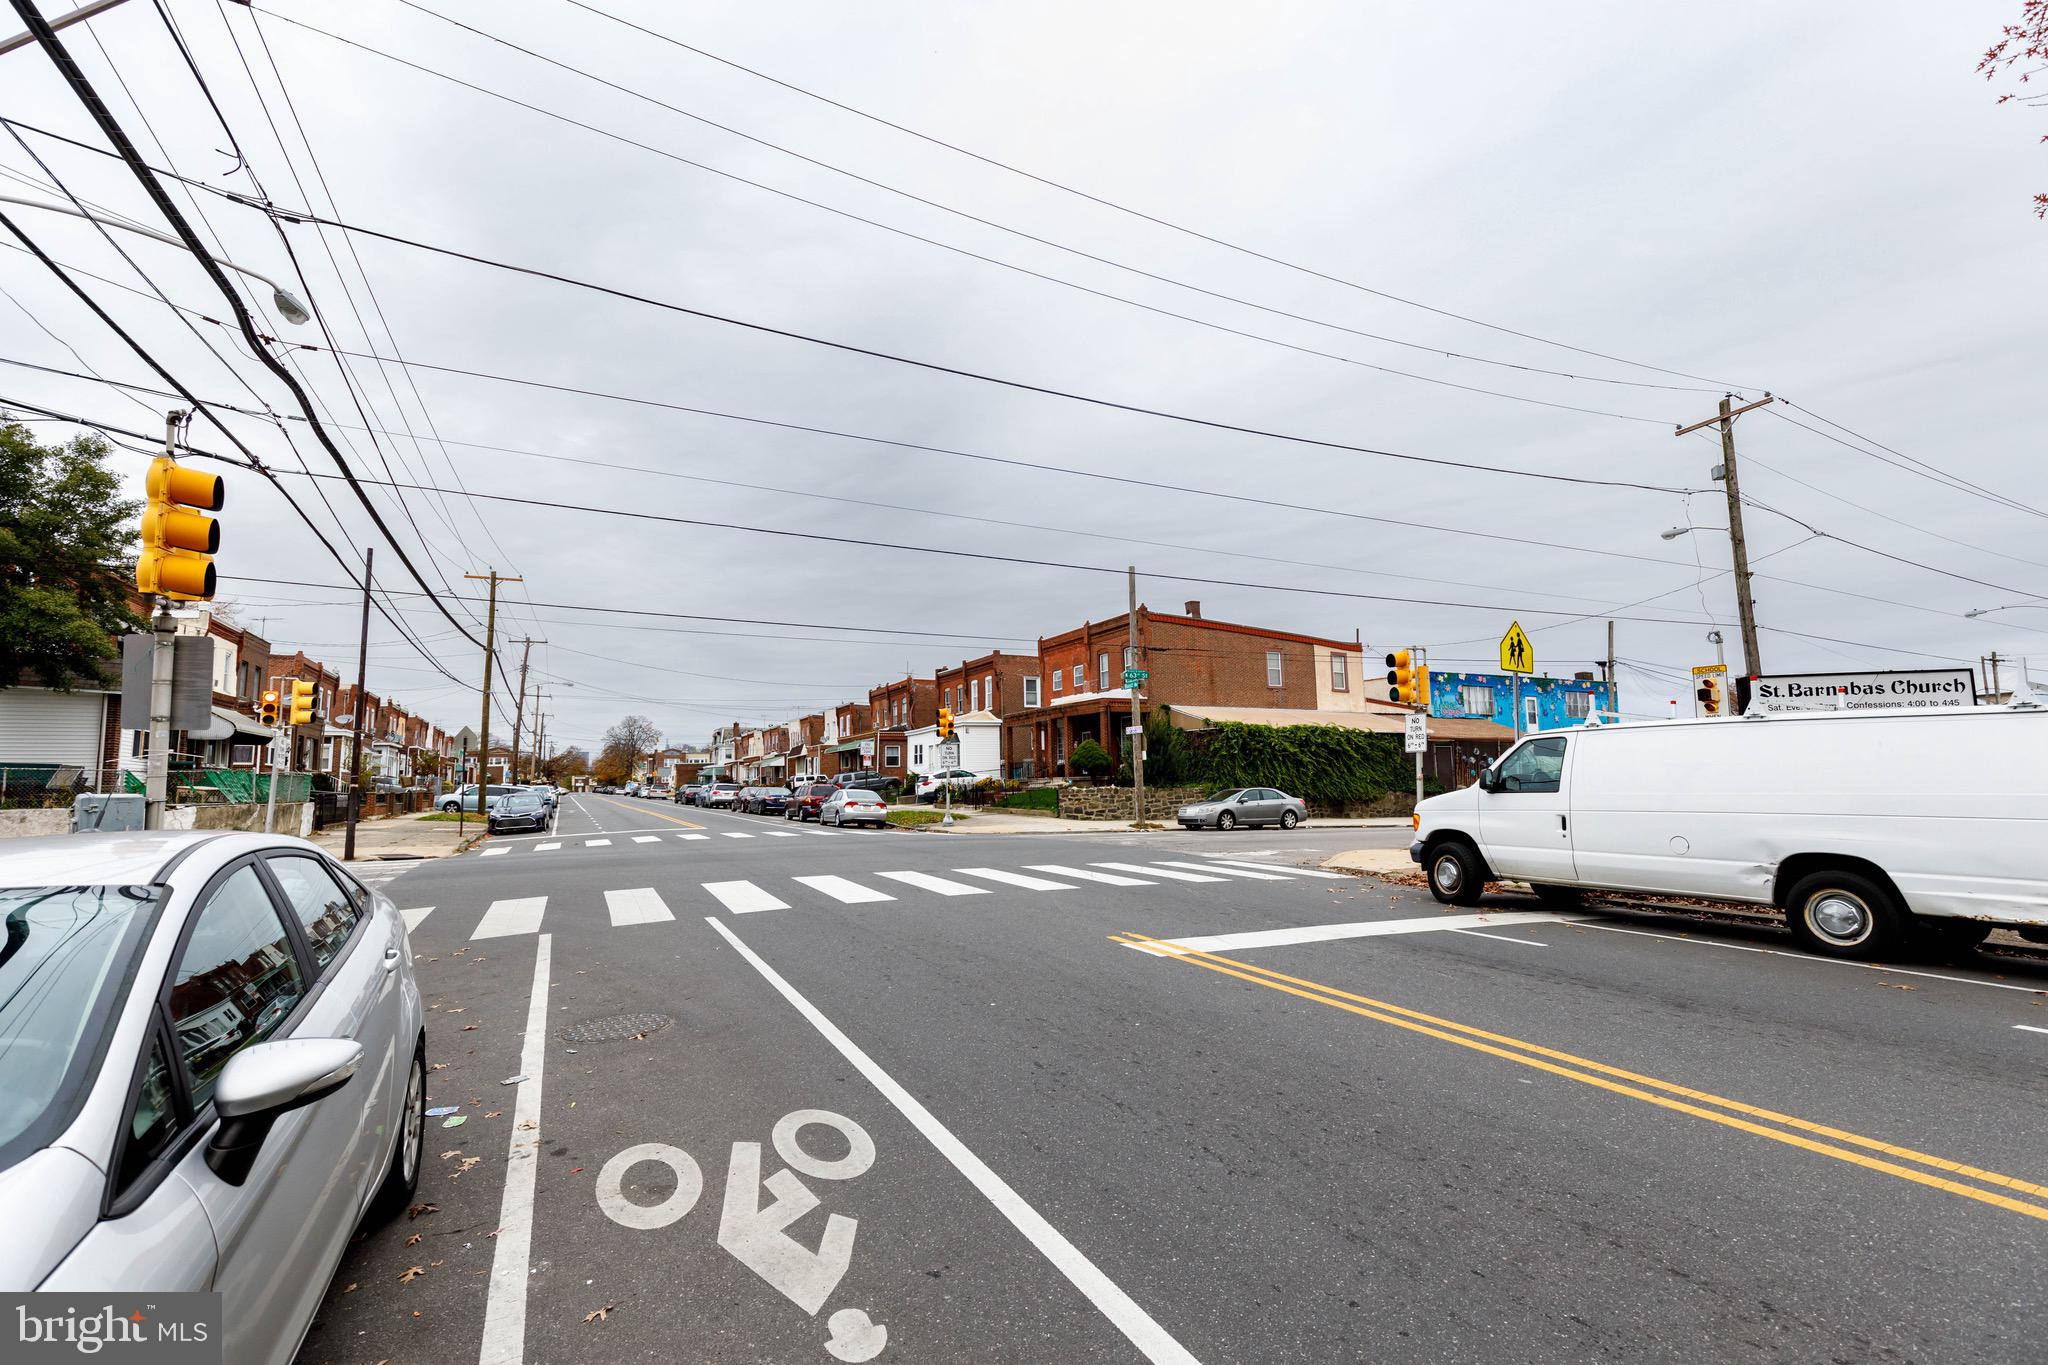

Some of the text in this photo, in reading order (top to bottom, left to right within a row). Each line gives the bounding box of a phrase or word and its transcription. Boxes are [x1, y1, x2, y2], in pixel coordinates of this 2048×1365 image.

[1760, 684, 1785, 698] St.
[1891, 678, 1966, 696] Church
[1846, 700, 1905, 710] Confessions:
[1907, 700, 1926, 708] 4:00
[1942, 698, 1960, 707] 4:45
